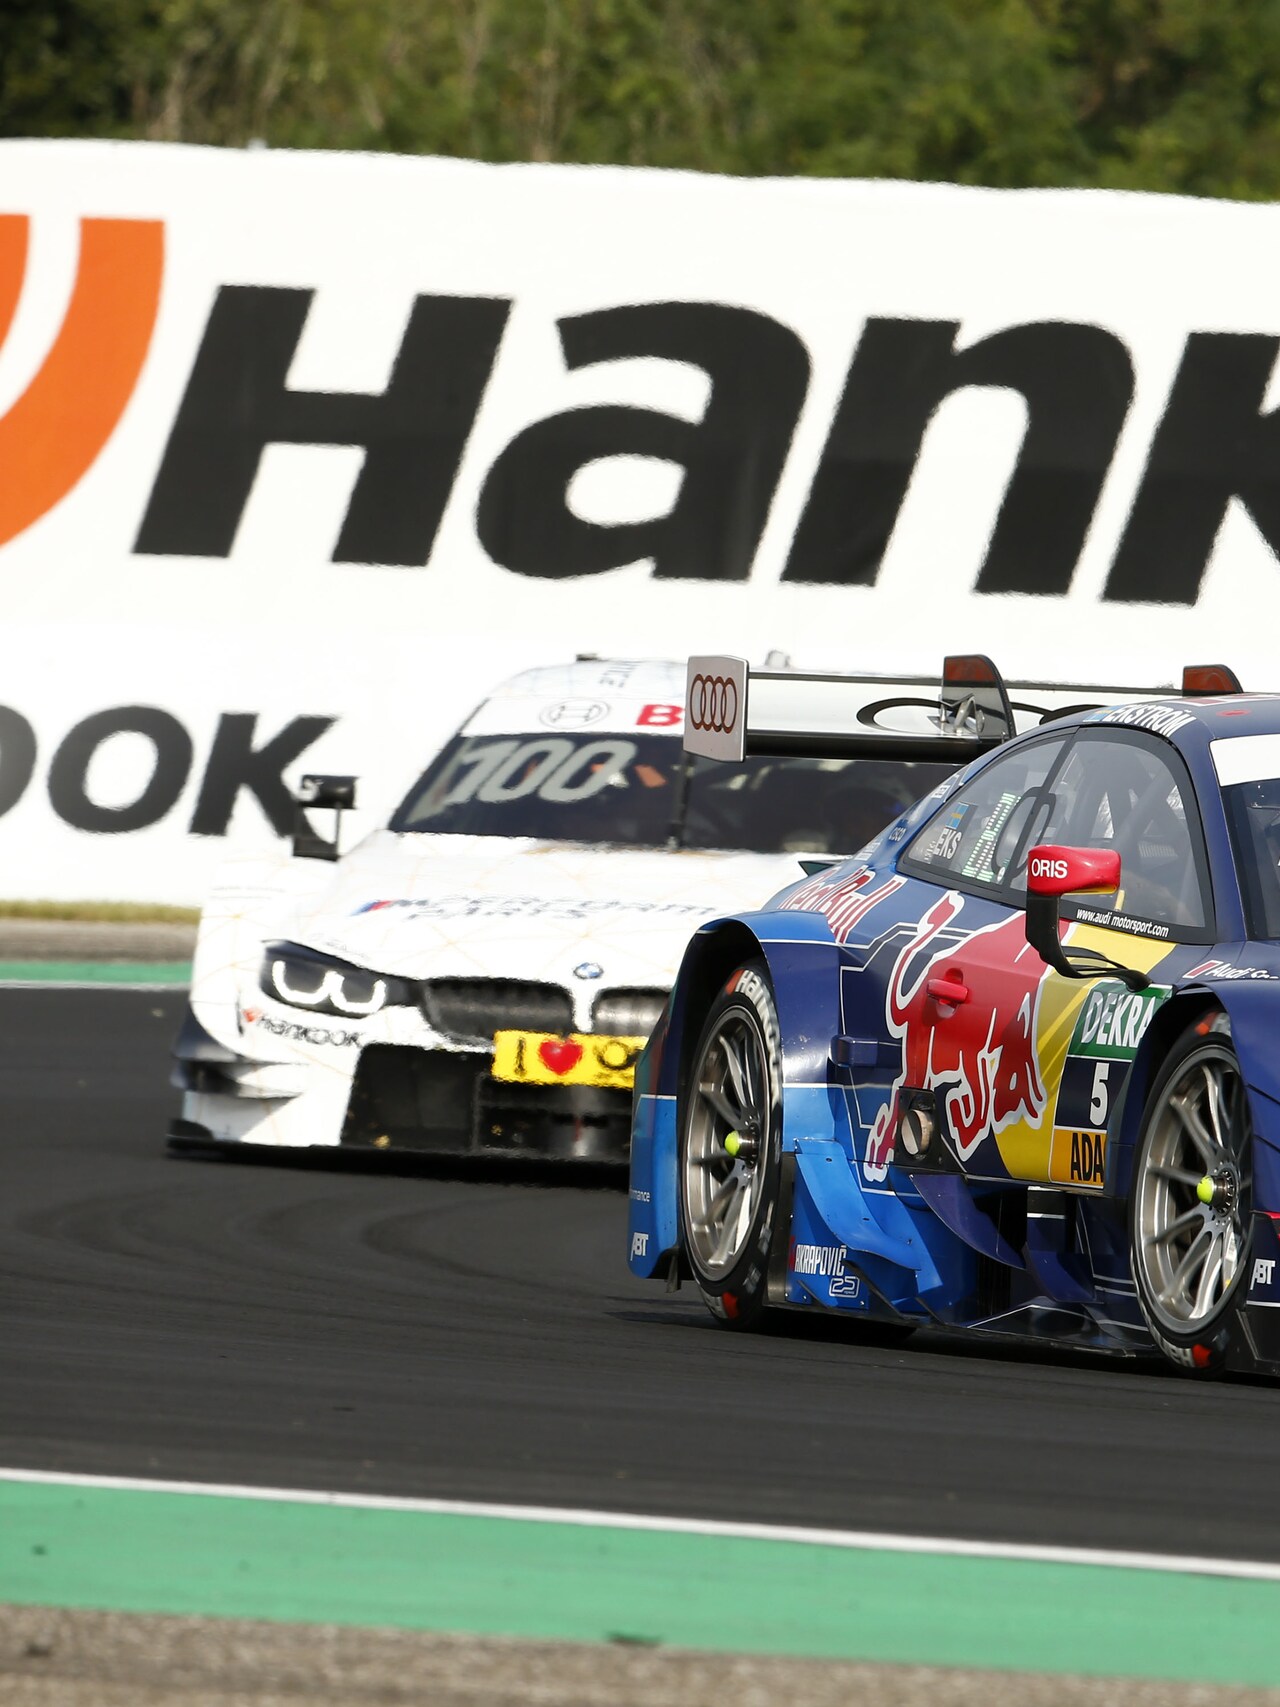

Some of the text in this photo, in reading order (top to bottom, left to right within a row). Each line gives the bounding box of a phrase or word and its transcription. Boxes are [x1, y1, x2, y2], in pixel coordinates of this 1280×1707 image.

[0, 704, 343, 842] OK
[1031, 858, 1068, 879] ORIS
[1081, 990, 1157, 1049] DEKRA
[1089, 1062, 1110, 1126] 5
